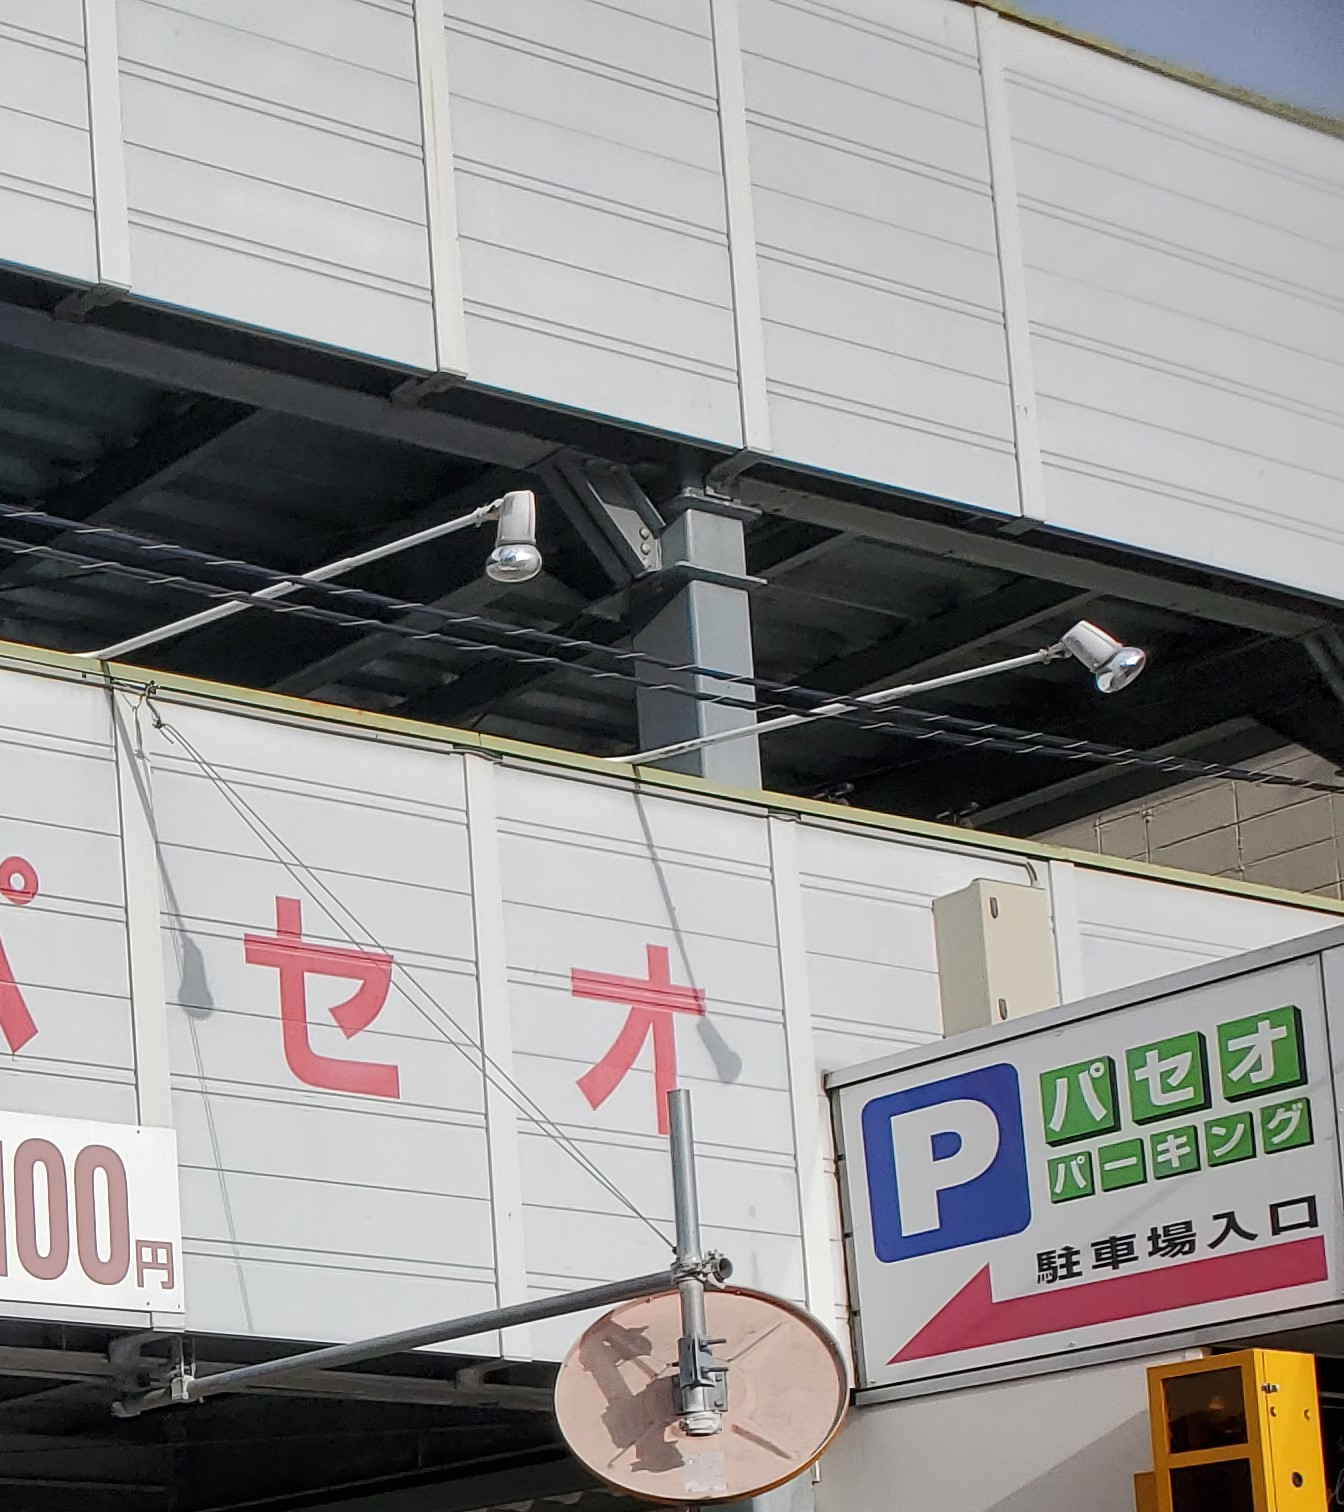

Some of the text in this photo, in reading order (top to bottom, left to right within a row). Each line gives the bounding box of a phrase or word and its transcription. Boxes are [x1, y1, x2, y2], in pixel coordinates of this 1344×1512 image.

[1048, 1018, 1288, 1133] パセオ
[890, 1098, 999, 1238] P
[1053, 1101, 1304, 1196] パーキング
[1036, 1194, 1320, 1285] 駐車場入口
